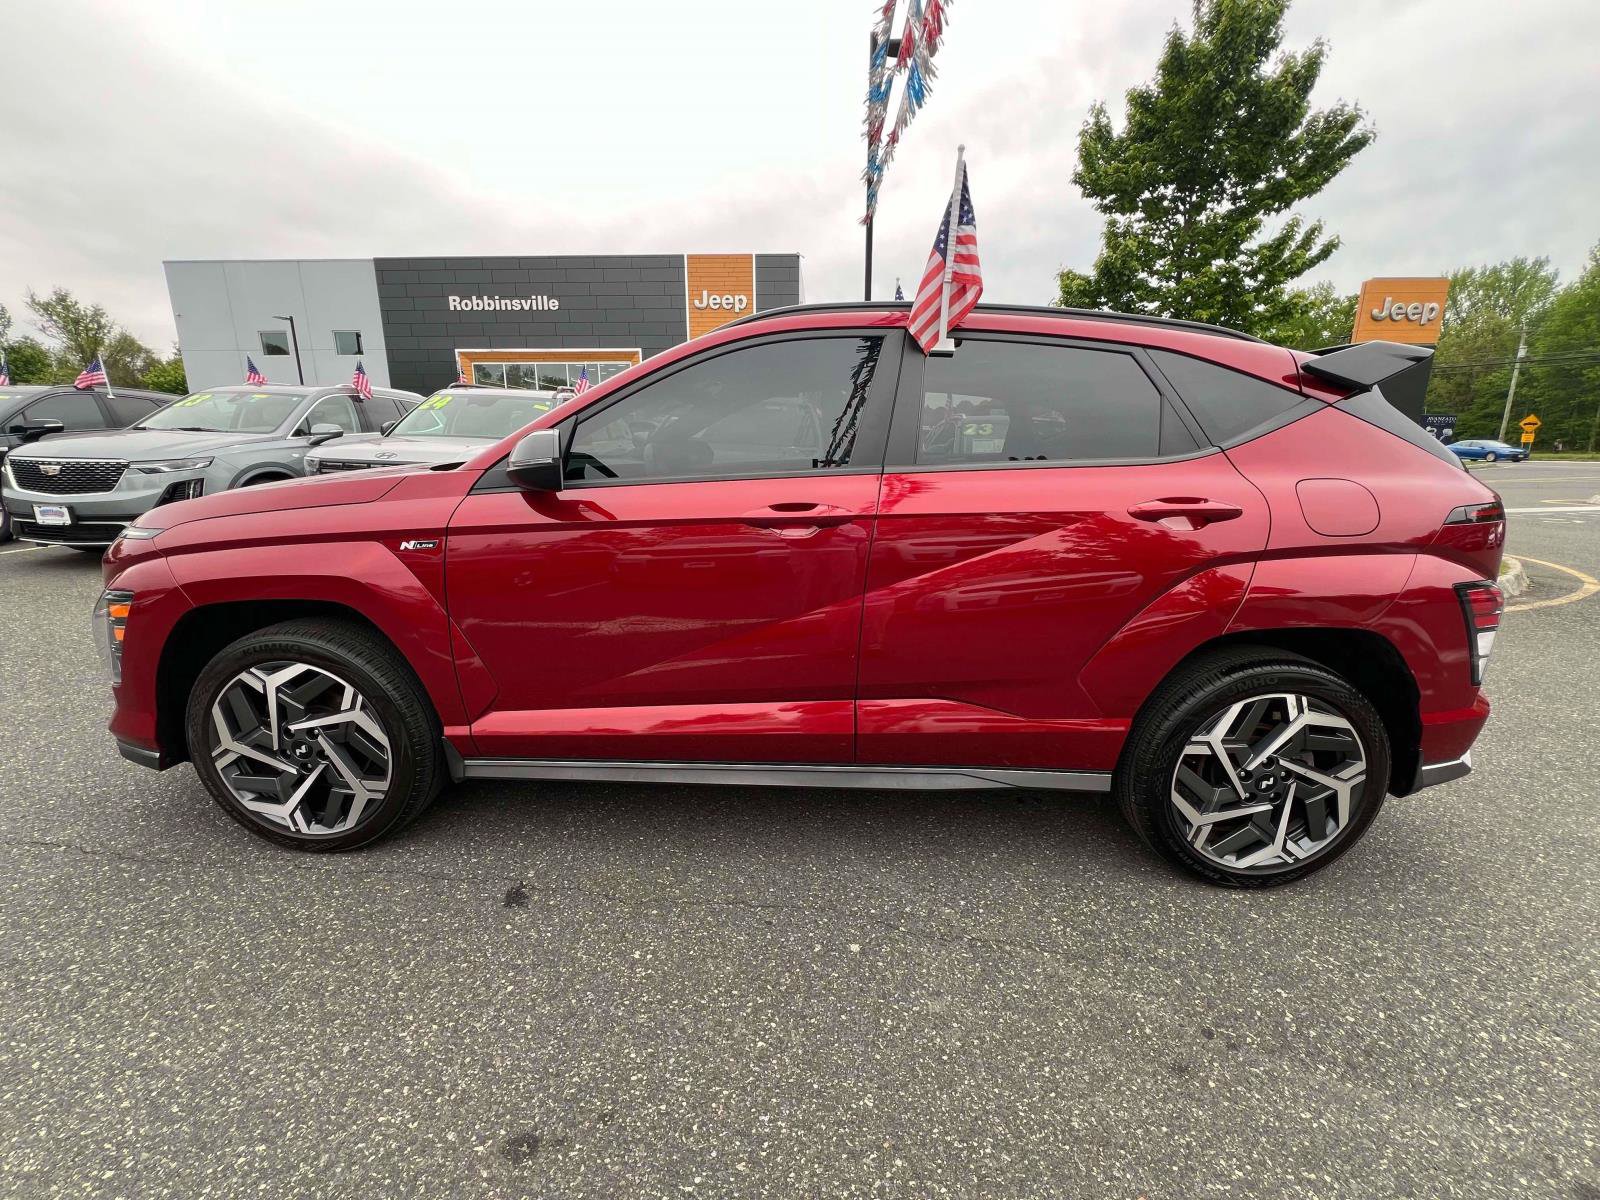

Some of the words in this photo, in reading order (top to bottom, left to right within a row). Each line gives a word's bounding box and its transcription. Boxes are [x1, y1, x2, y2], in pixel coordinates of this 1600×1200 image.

[448, 295, 559, 311] Robbinsville
[693, 290, 748, 313] Jeep
[1371, 296, 1440, 326] Jeep
[963, 423, 992, 435] 23
